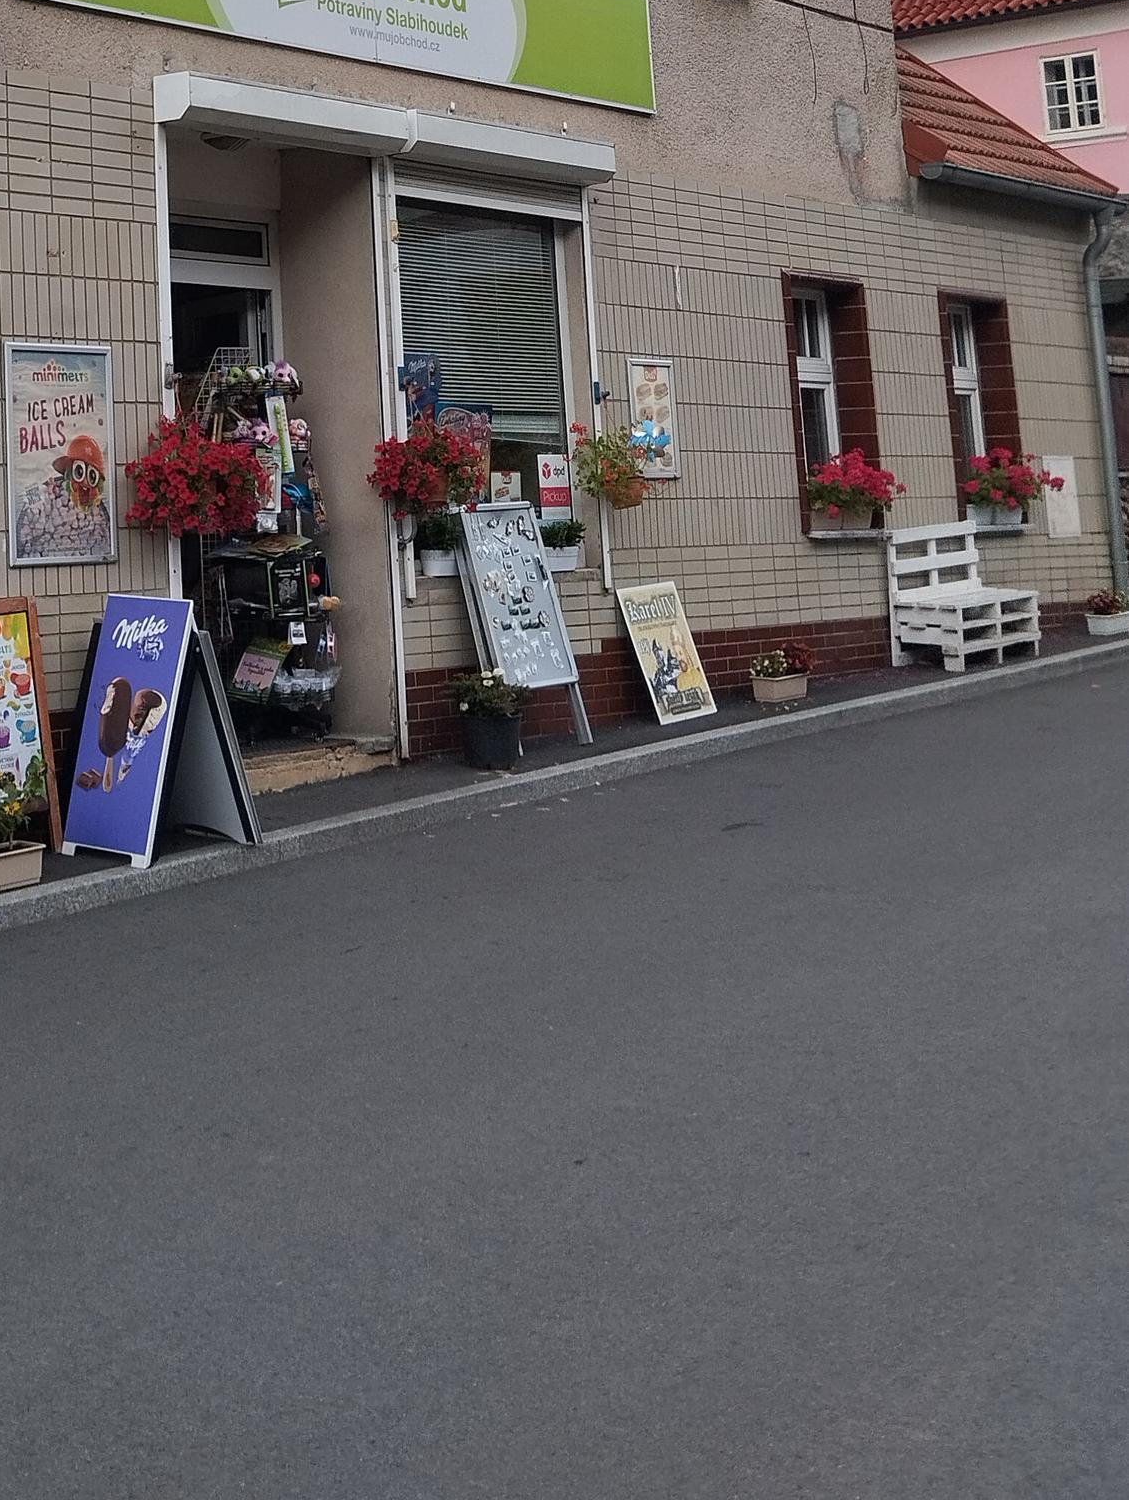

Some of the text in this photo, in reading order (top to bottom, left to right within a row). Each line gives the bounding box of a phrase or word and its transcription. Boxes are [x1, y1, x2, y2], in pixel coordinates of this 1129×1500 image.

[386, 7, 469, 40] Slabihoudek
[349, 25, 441, 52] www.mujobchod.cz
[27, 393, 95, 422] ICE CREAM
[19, 420, 67, 454] BALLS
[552, 465, 566, 479] dpd
[543, 491, 567, 503] Pickup
[625, 597, 662, 622] Karel
[112, 614, 169, 649] Milka
